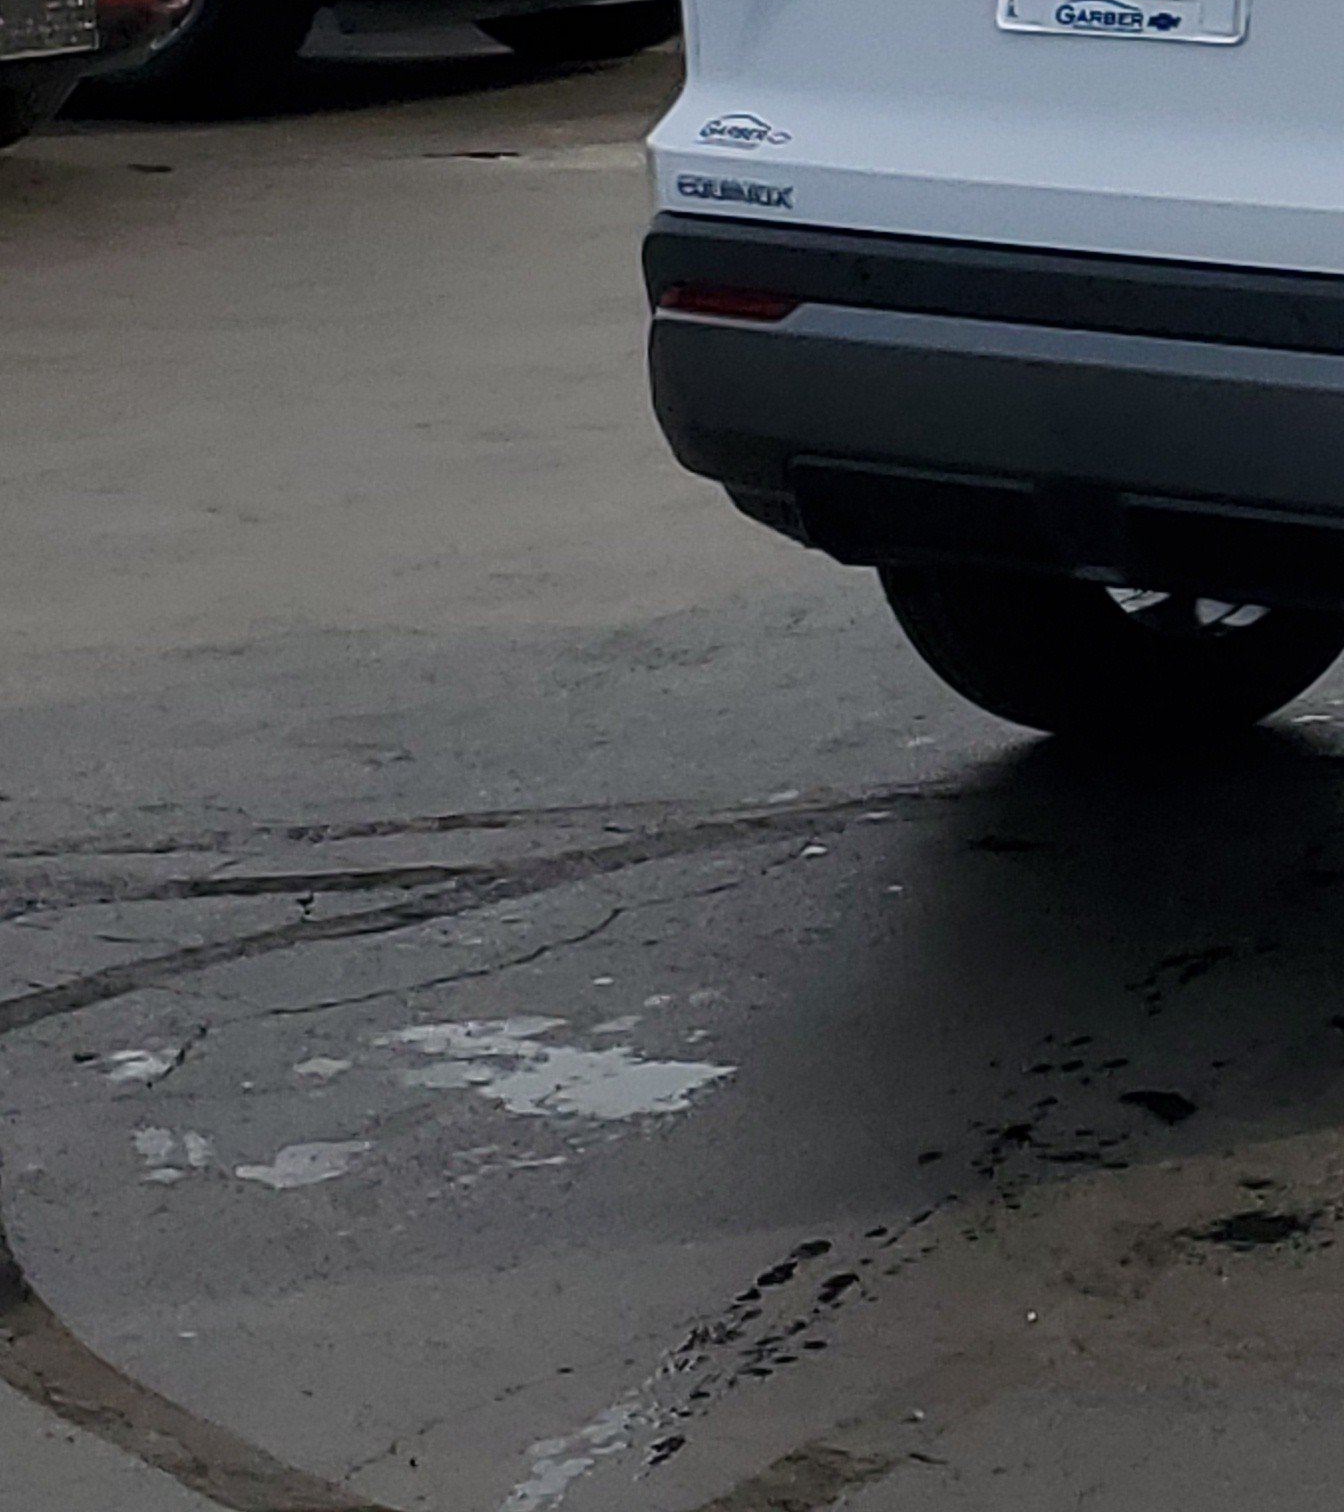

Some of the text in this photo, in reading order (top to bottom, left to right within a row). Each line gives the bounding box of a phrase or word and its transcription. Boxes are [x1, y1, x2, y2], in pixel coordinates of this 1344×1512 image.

[1055, 4, 1143, 27] GARBER
[699, 120, 769, 140] GARBER
[677, 174, 794, 209] EQUINOX
